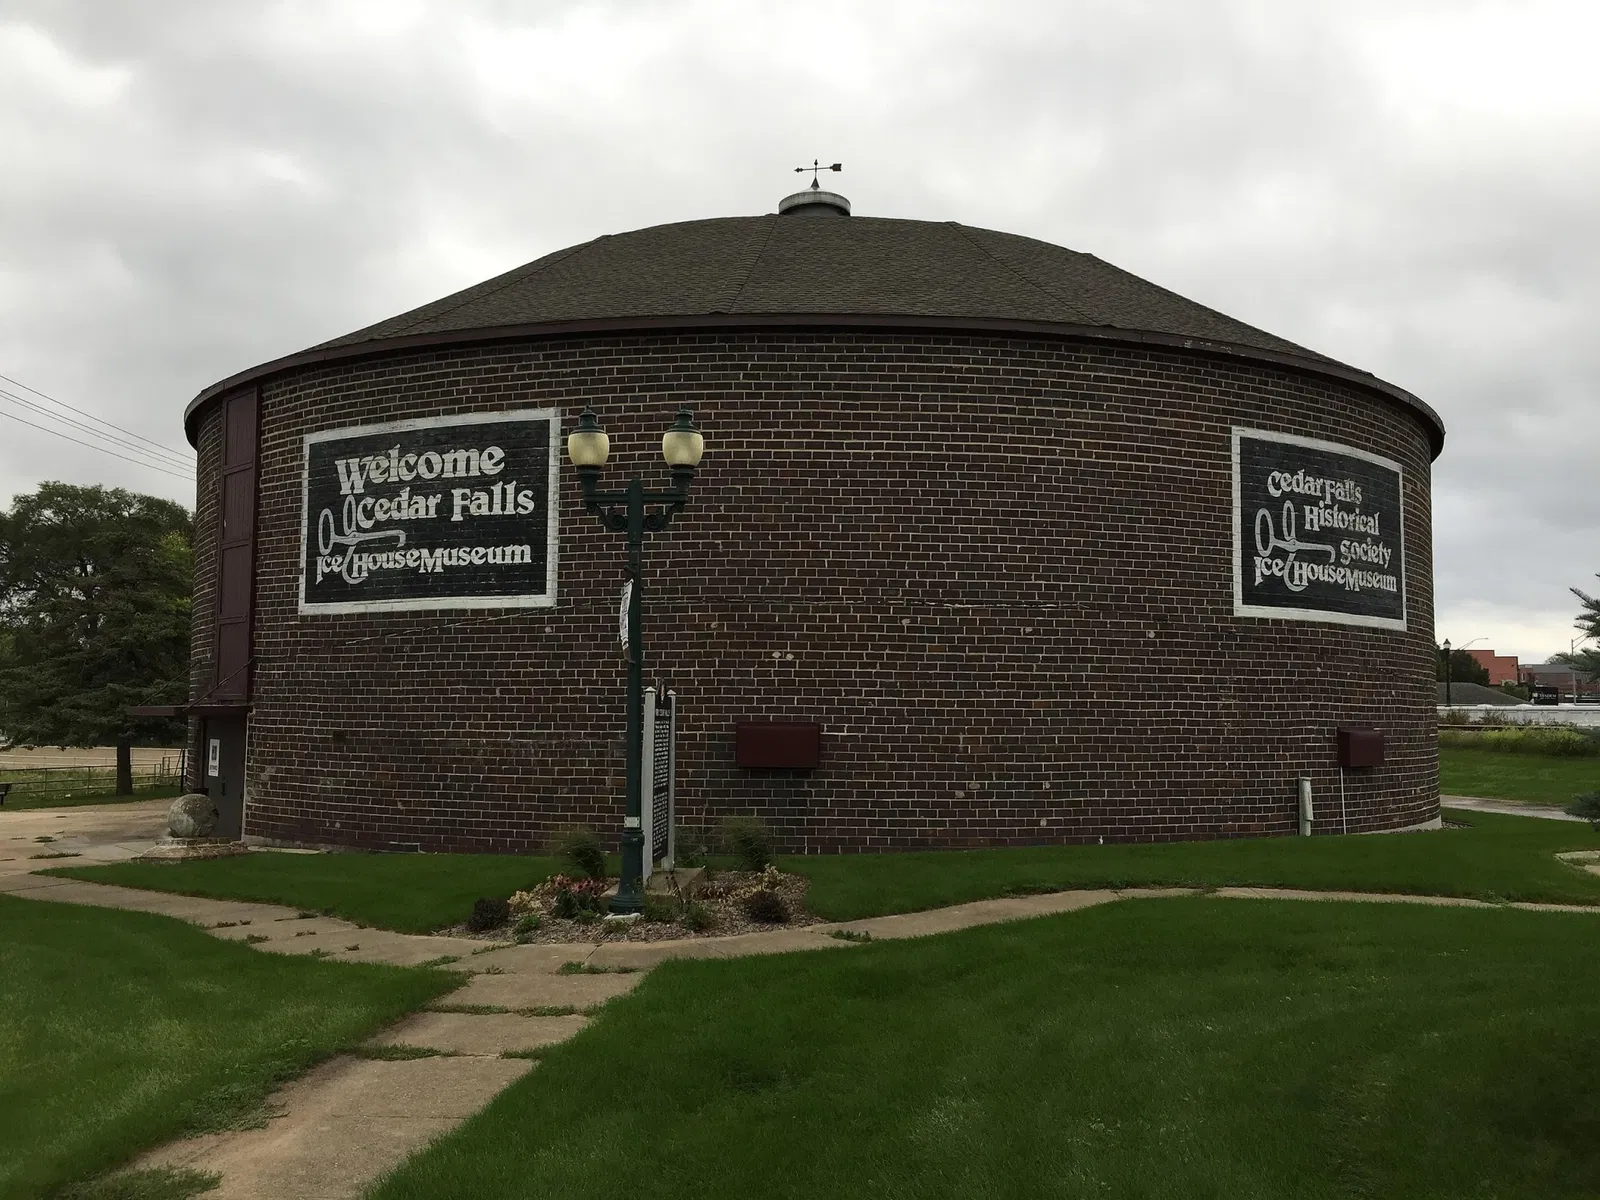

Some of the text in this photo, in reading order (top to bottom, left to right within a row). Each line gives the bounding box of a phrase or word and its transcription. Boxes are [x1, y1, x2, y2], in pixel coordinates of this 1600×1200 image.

[335, 444, 505, 495] Welcome
[1267, 469, 1362, 505] Cedar Falls
[357, 480, 535, 528] Cedar Falls
[1303, 500, 1380, 536] Historical
[315, 554, 344, 585] Ice
[1253, 556, 1285, 586] Ice
[1340, 538, 1392, 569] Society
